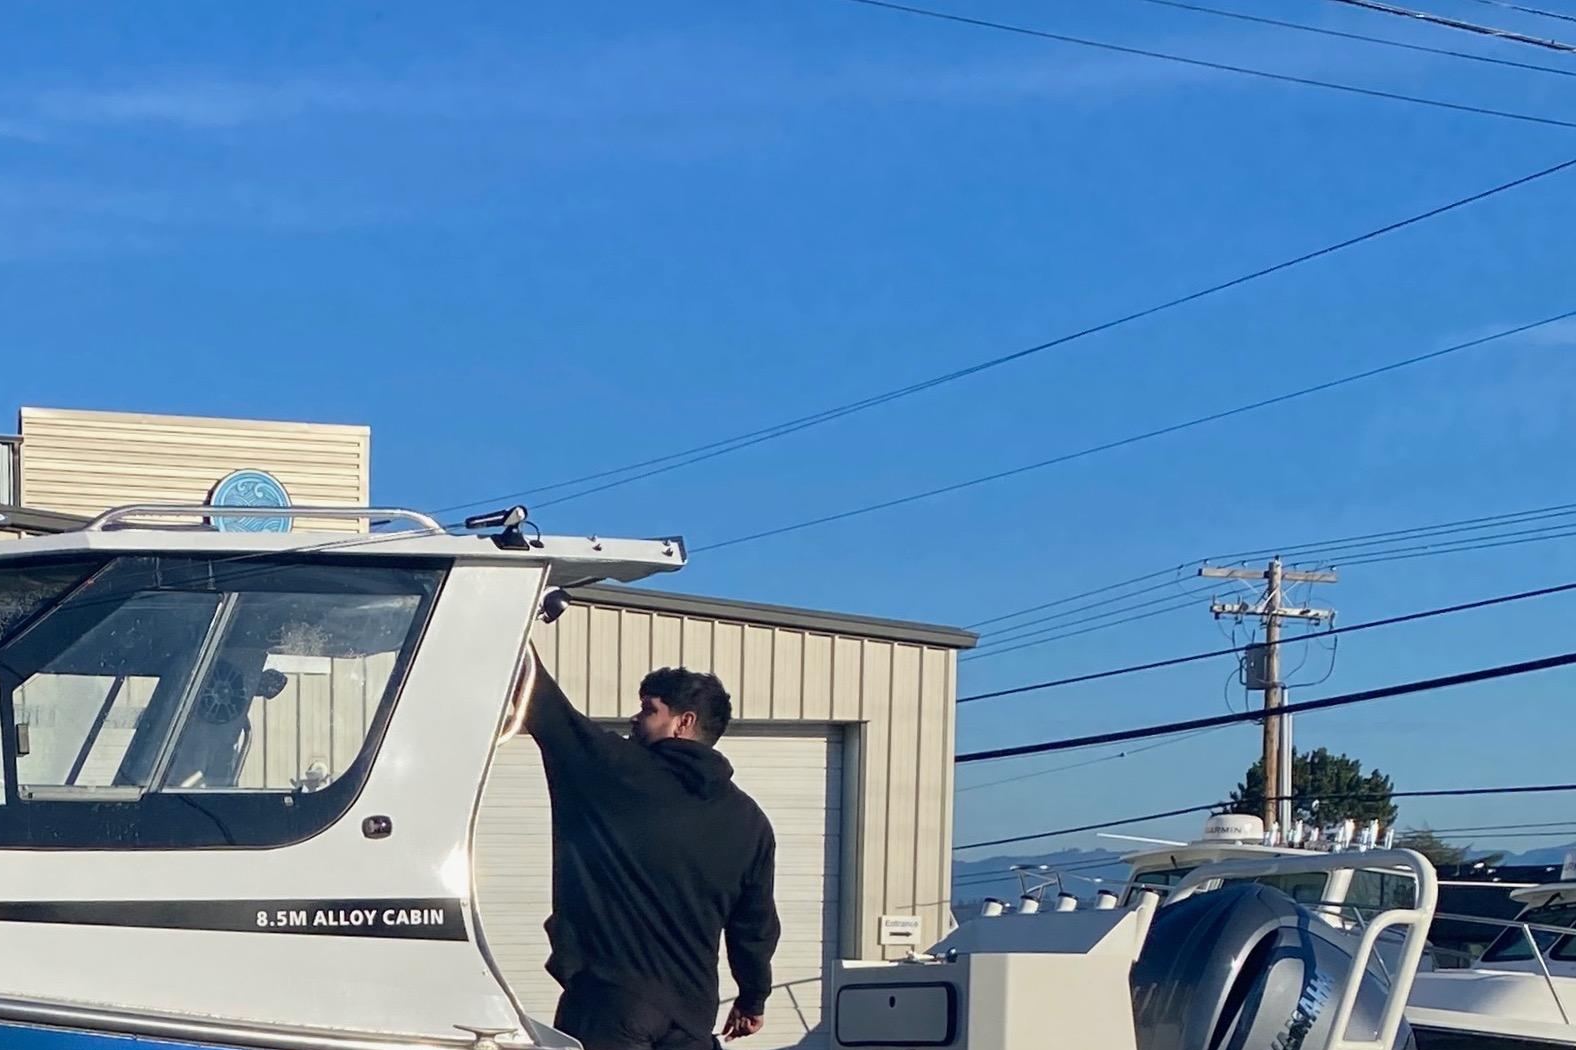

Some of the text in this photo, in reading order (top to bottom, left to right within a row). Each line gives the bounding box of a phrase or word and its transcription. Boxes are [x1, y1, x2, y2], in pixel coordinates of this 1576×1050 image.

[255, 908, 444, 928] 8.5M ALLOY CABIN
